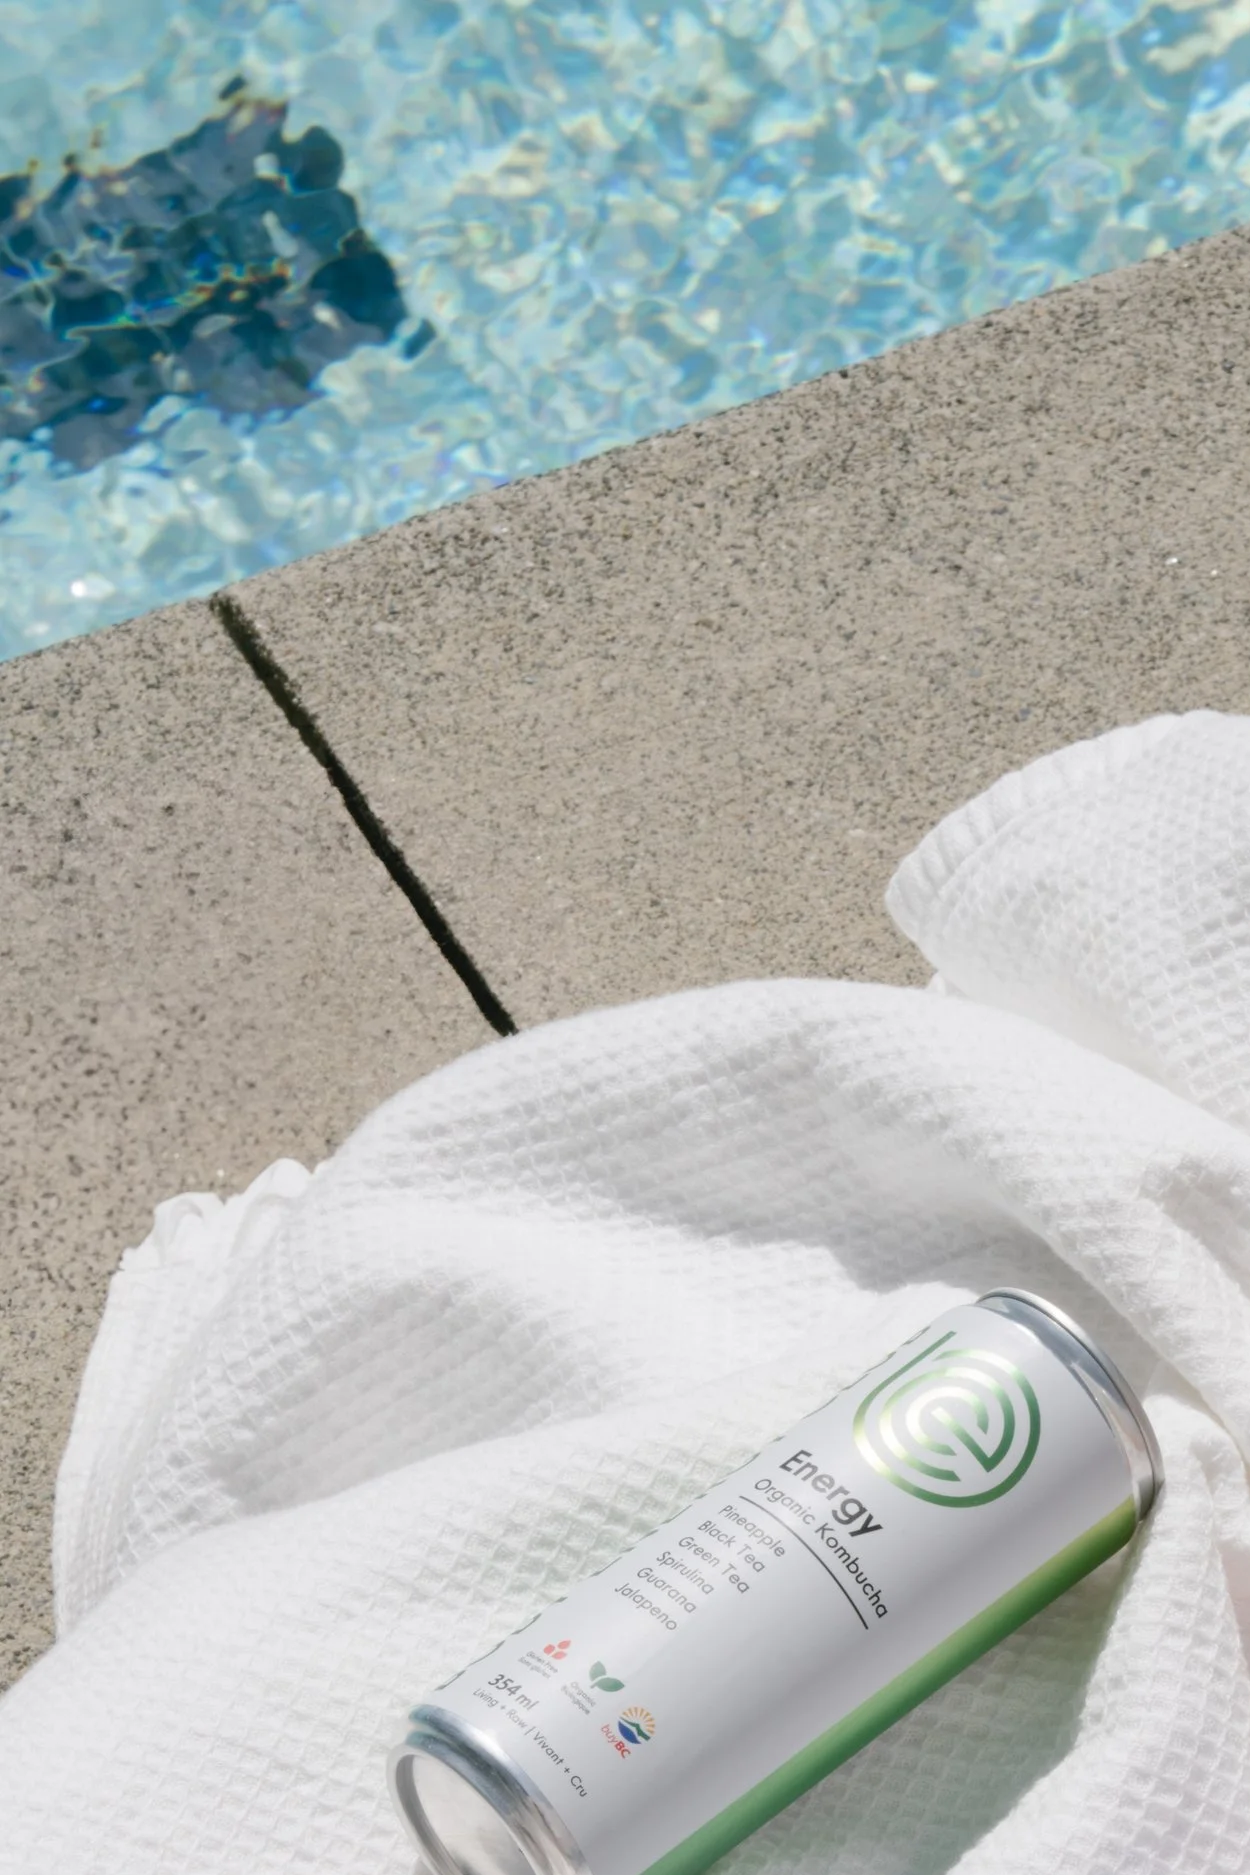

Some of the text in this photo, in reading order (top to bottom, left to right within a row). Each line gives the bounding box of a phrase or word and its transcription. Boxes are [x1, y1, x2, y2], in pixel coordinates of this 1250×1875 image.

[779, 1450, 882, 1537] Energy
[698, 1520, 766, 1572] Black Tea
[718, 1504, 786, 1558] Pineapple
[755, 1479, 888, 1618] Organic Kombucha
[637, 1567, 696, 1614] Guarana
[656, 1551, 714, 1595] Spirulina
[678, 1537, 750, 1594] Green Tea
[614, 1582, 678, 1632] Jalapeno
[488, 1674, 540, 1711] 354 ml
[472, 1688, 498, 1708] Living
[506, 1709, 529, 1728] Raw
[534, 1731, 564, 1766] Vivant
[564, 1766, 570, 1774] +
[570, 1775, 588, 1797] Cru
[601, 1724, 631, 1759] buyBC
